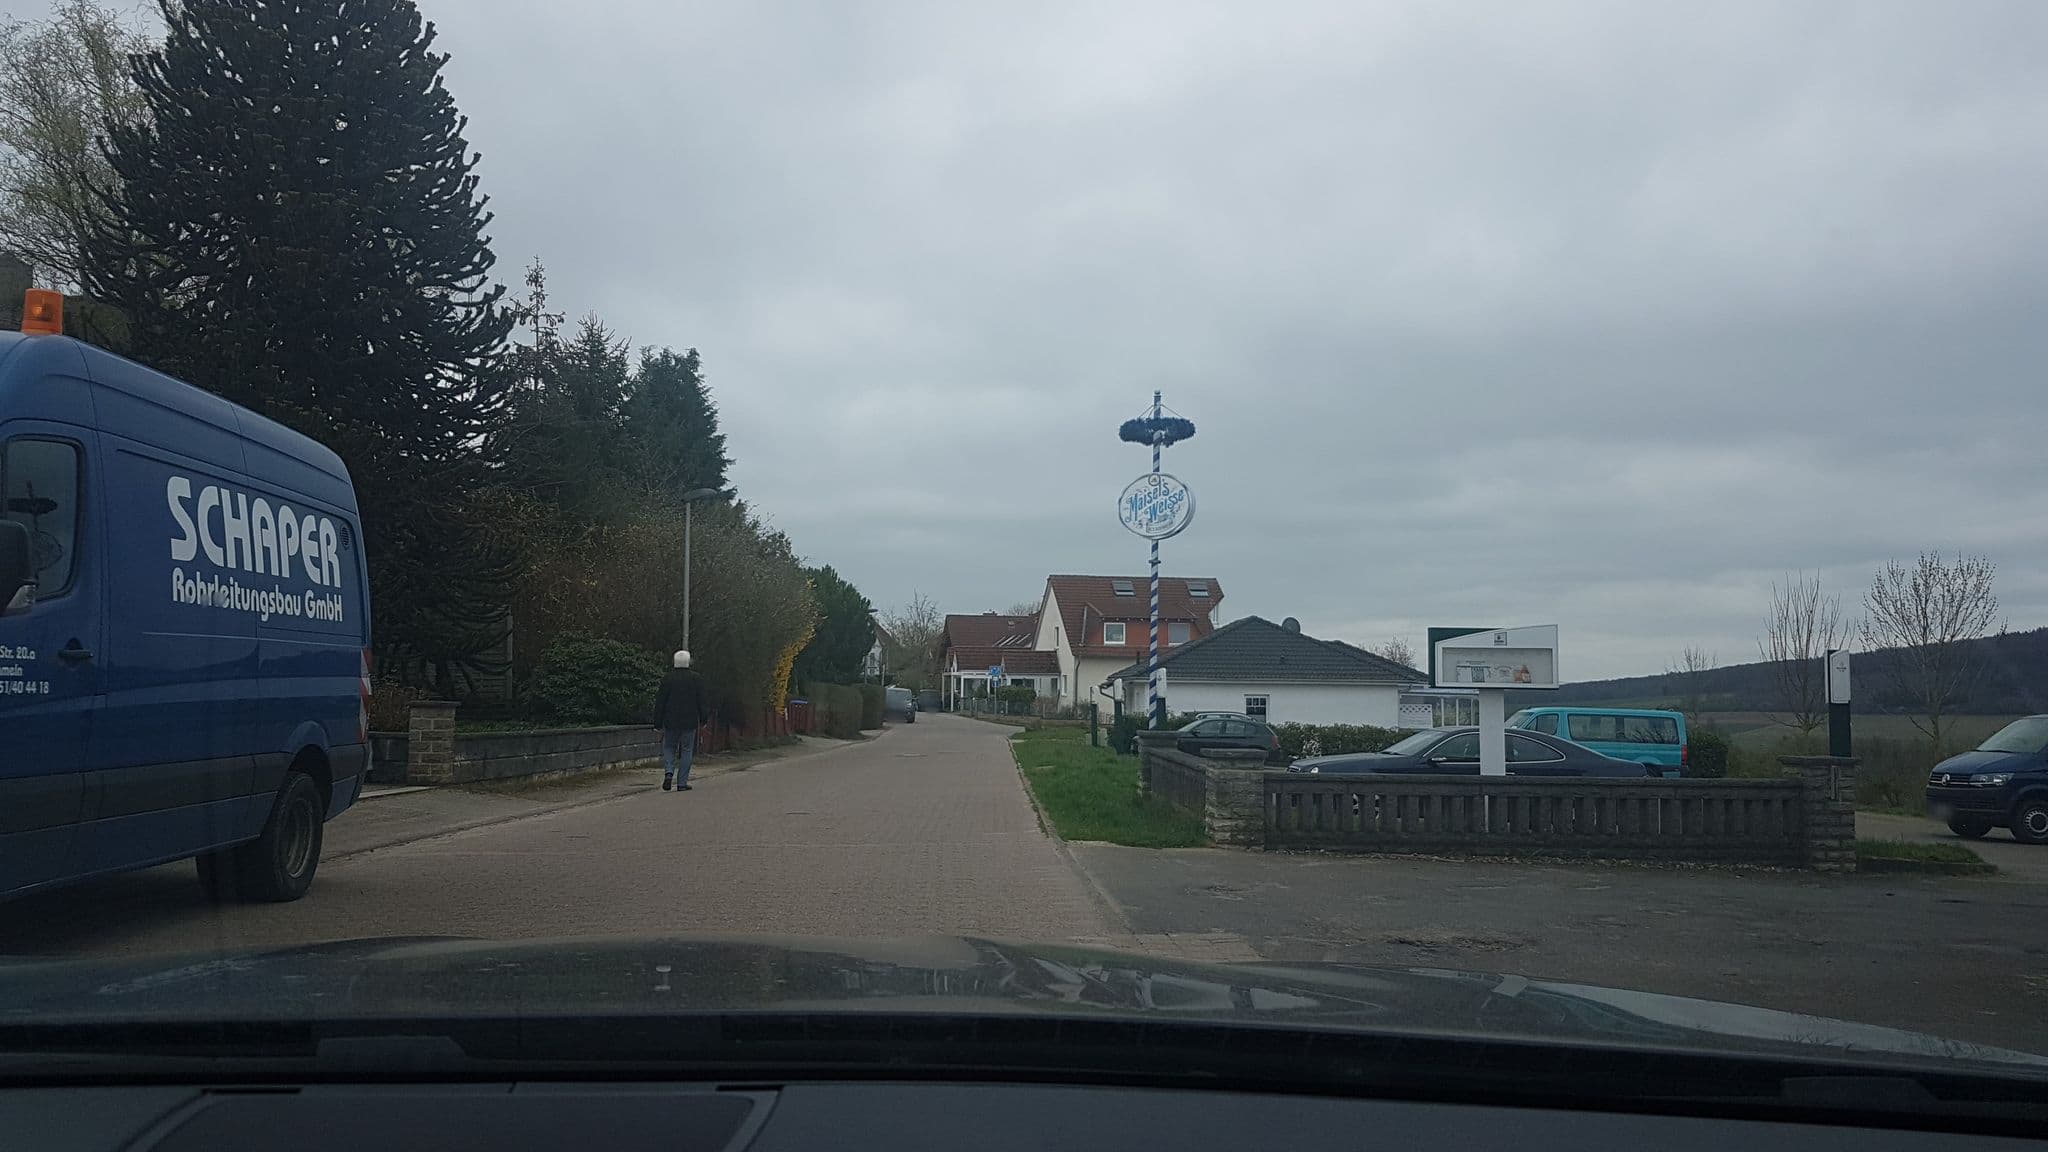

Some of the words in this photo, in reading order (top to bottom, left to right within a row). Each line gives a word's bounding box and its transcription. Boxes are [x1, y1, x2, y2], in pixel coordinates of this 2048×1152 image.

[167, 476, 341, 588] SCHAPER
[1145, 489, 1184, 522] Weisse
[172, 567, 301, 622] Rohrleitungsbau
[305, 589, 343, 622] GmbH
